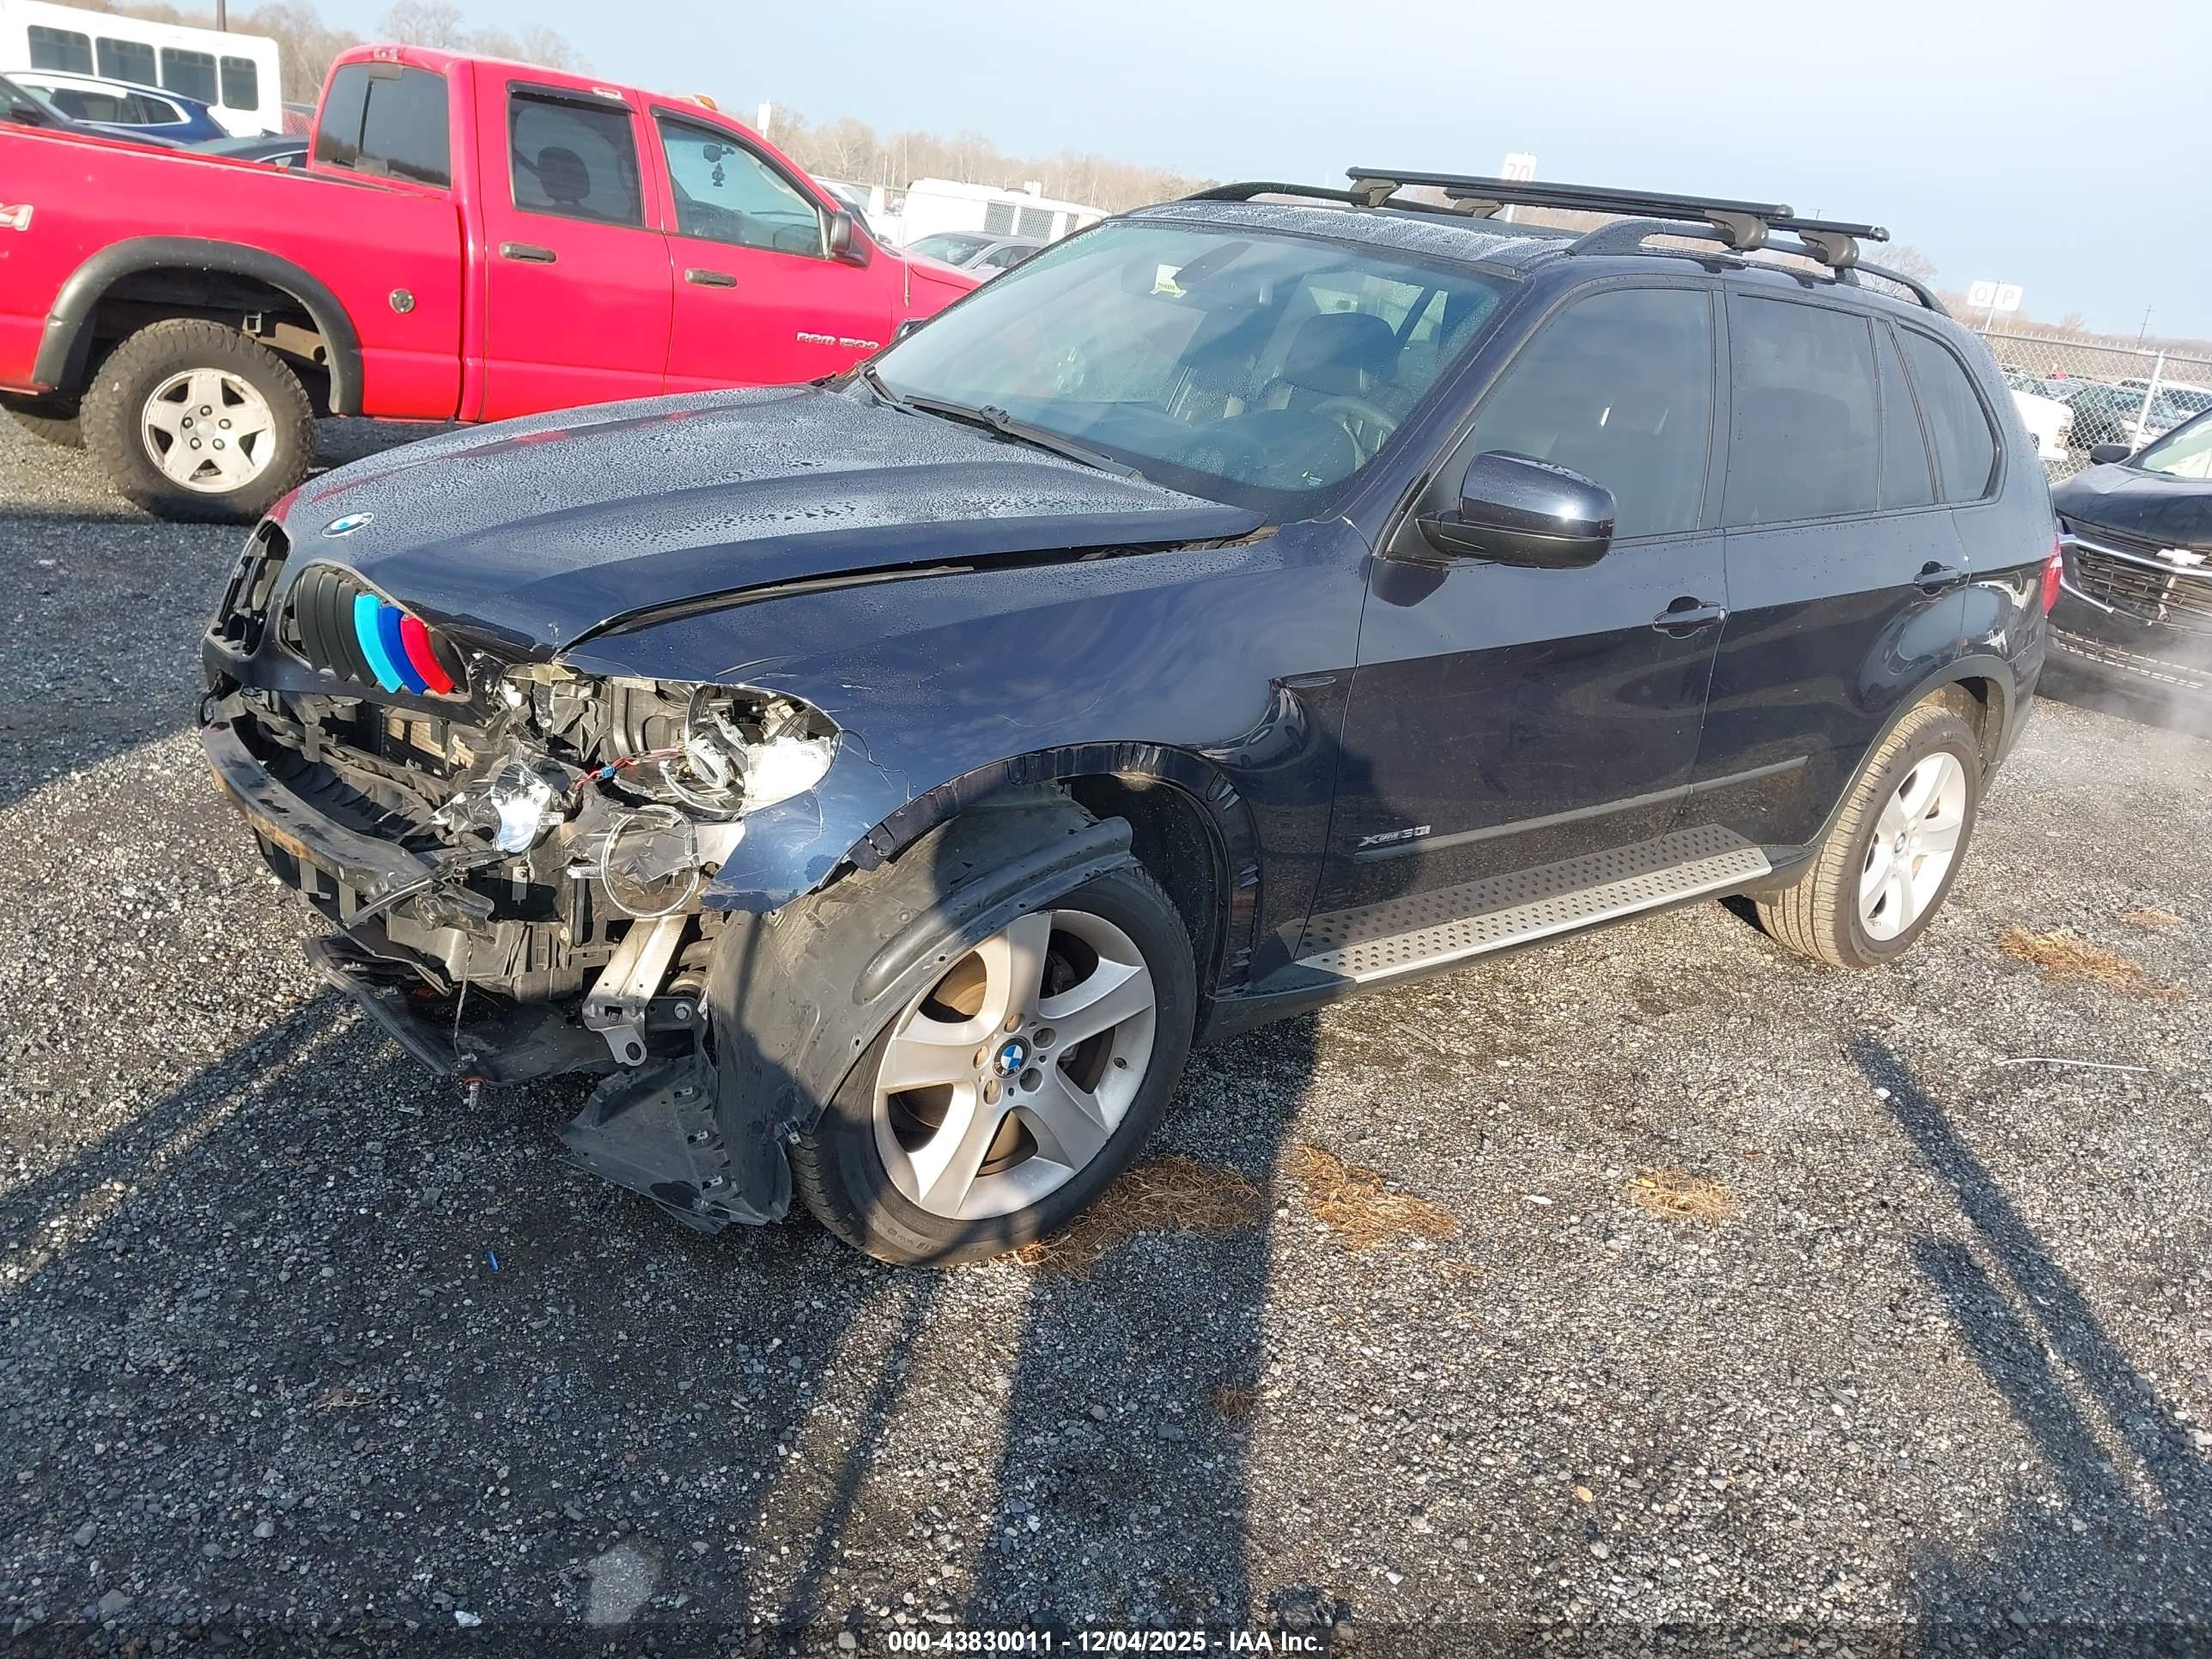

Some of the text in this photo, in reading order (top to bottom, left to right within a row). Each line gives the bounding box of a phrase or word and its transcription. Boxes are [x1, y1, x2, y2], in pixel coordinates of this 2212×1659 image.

[2002, 290, 2015, 305] P
[796, 331, 880, 349] RAM 1500
